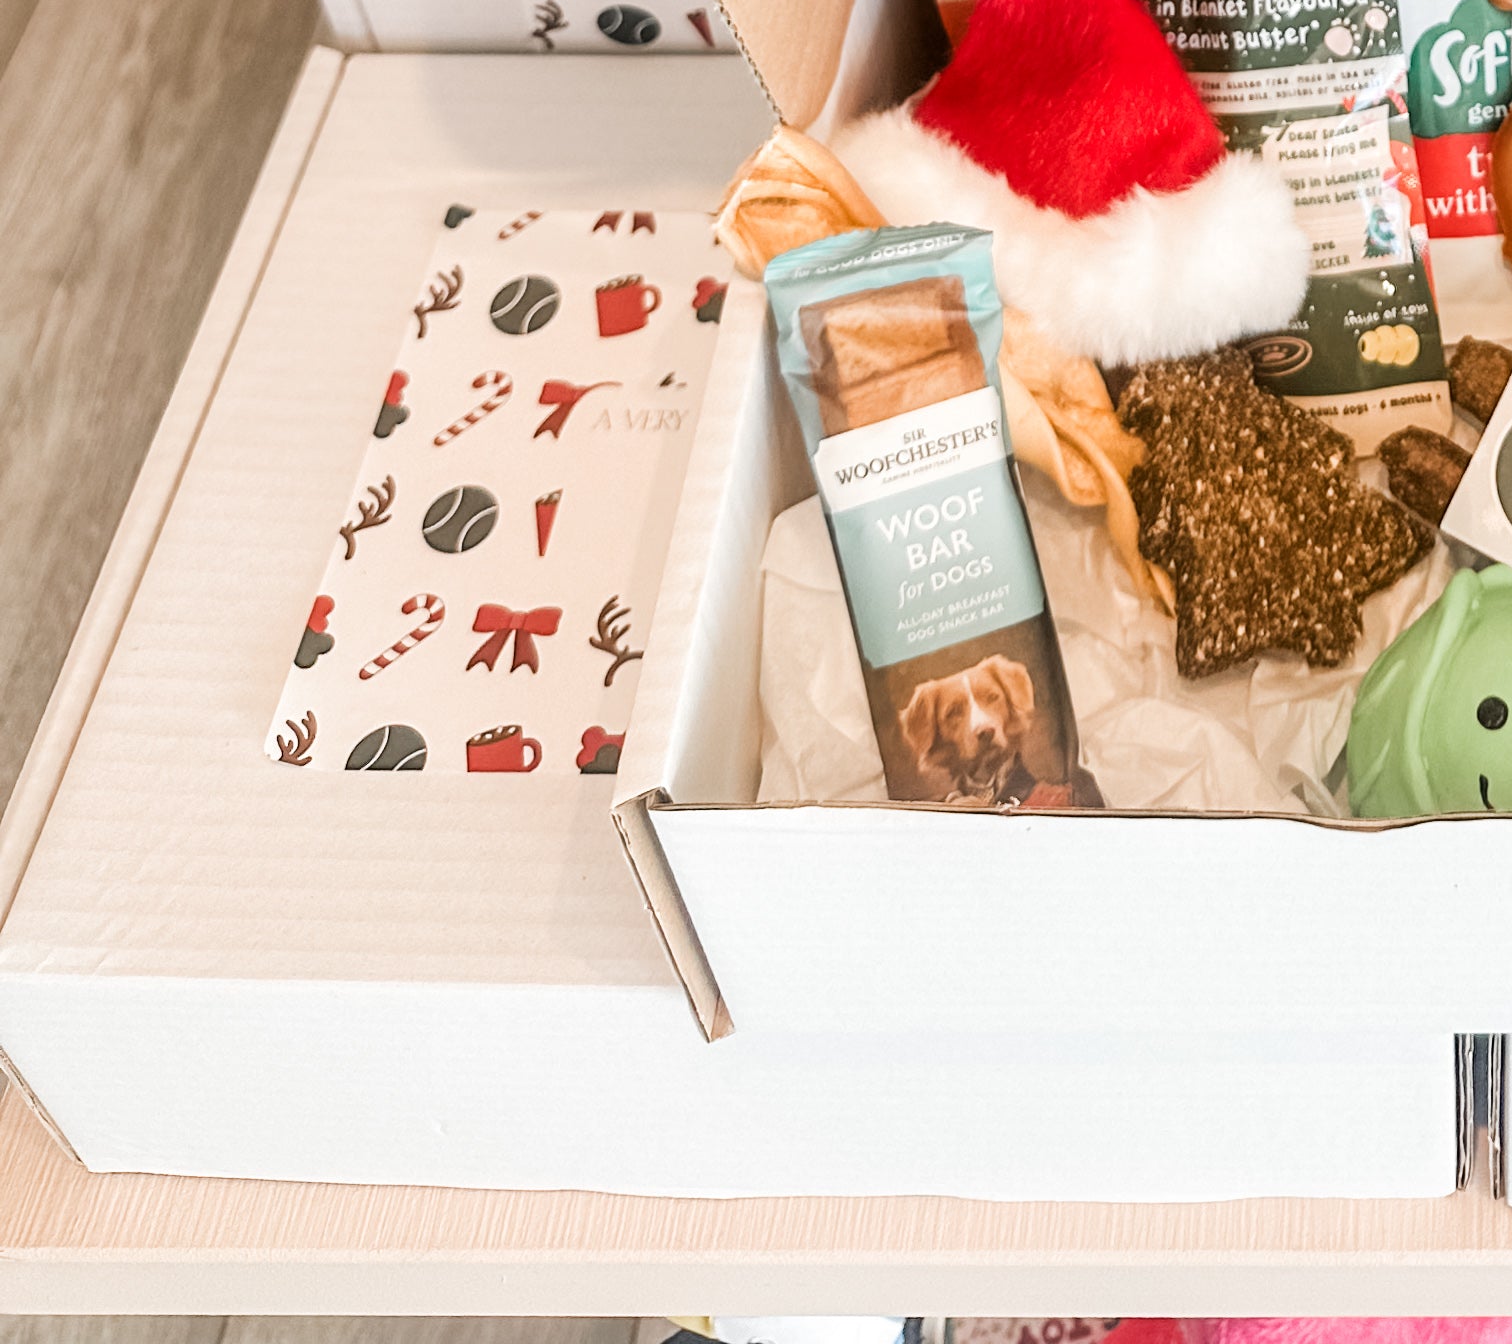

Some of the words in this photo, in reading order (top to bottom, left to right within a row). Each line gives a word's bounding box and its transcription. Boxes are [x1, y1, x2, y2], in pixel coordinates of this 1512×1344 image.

[1166, 26, 1230, 51] Peanut
[1232, 24, 1311, 52] Butter
[1426, 187, 1499, 218] with
[870, 241, 918, 261] DOGS
[922, 231, 967, 250] ONLY
[835, 419, 999, 486] WOOFCHESTER'S
[903, 427, 928, 445] SIR
[875, 486, 985, 544] WOOF
[906, 528, 975, 572] BAR
[898, 580, 925, 609] for
[930, 555, 995, 592] DOGS
[897, 605, 946, 631] ALL-DAY
[947, 583, 1012, 614] BREAKFAST
[907, 625, 936, 643] DOG
[938, 611, 979, 635] SNACK
[981, 602, 1006, 619] BAR
